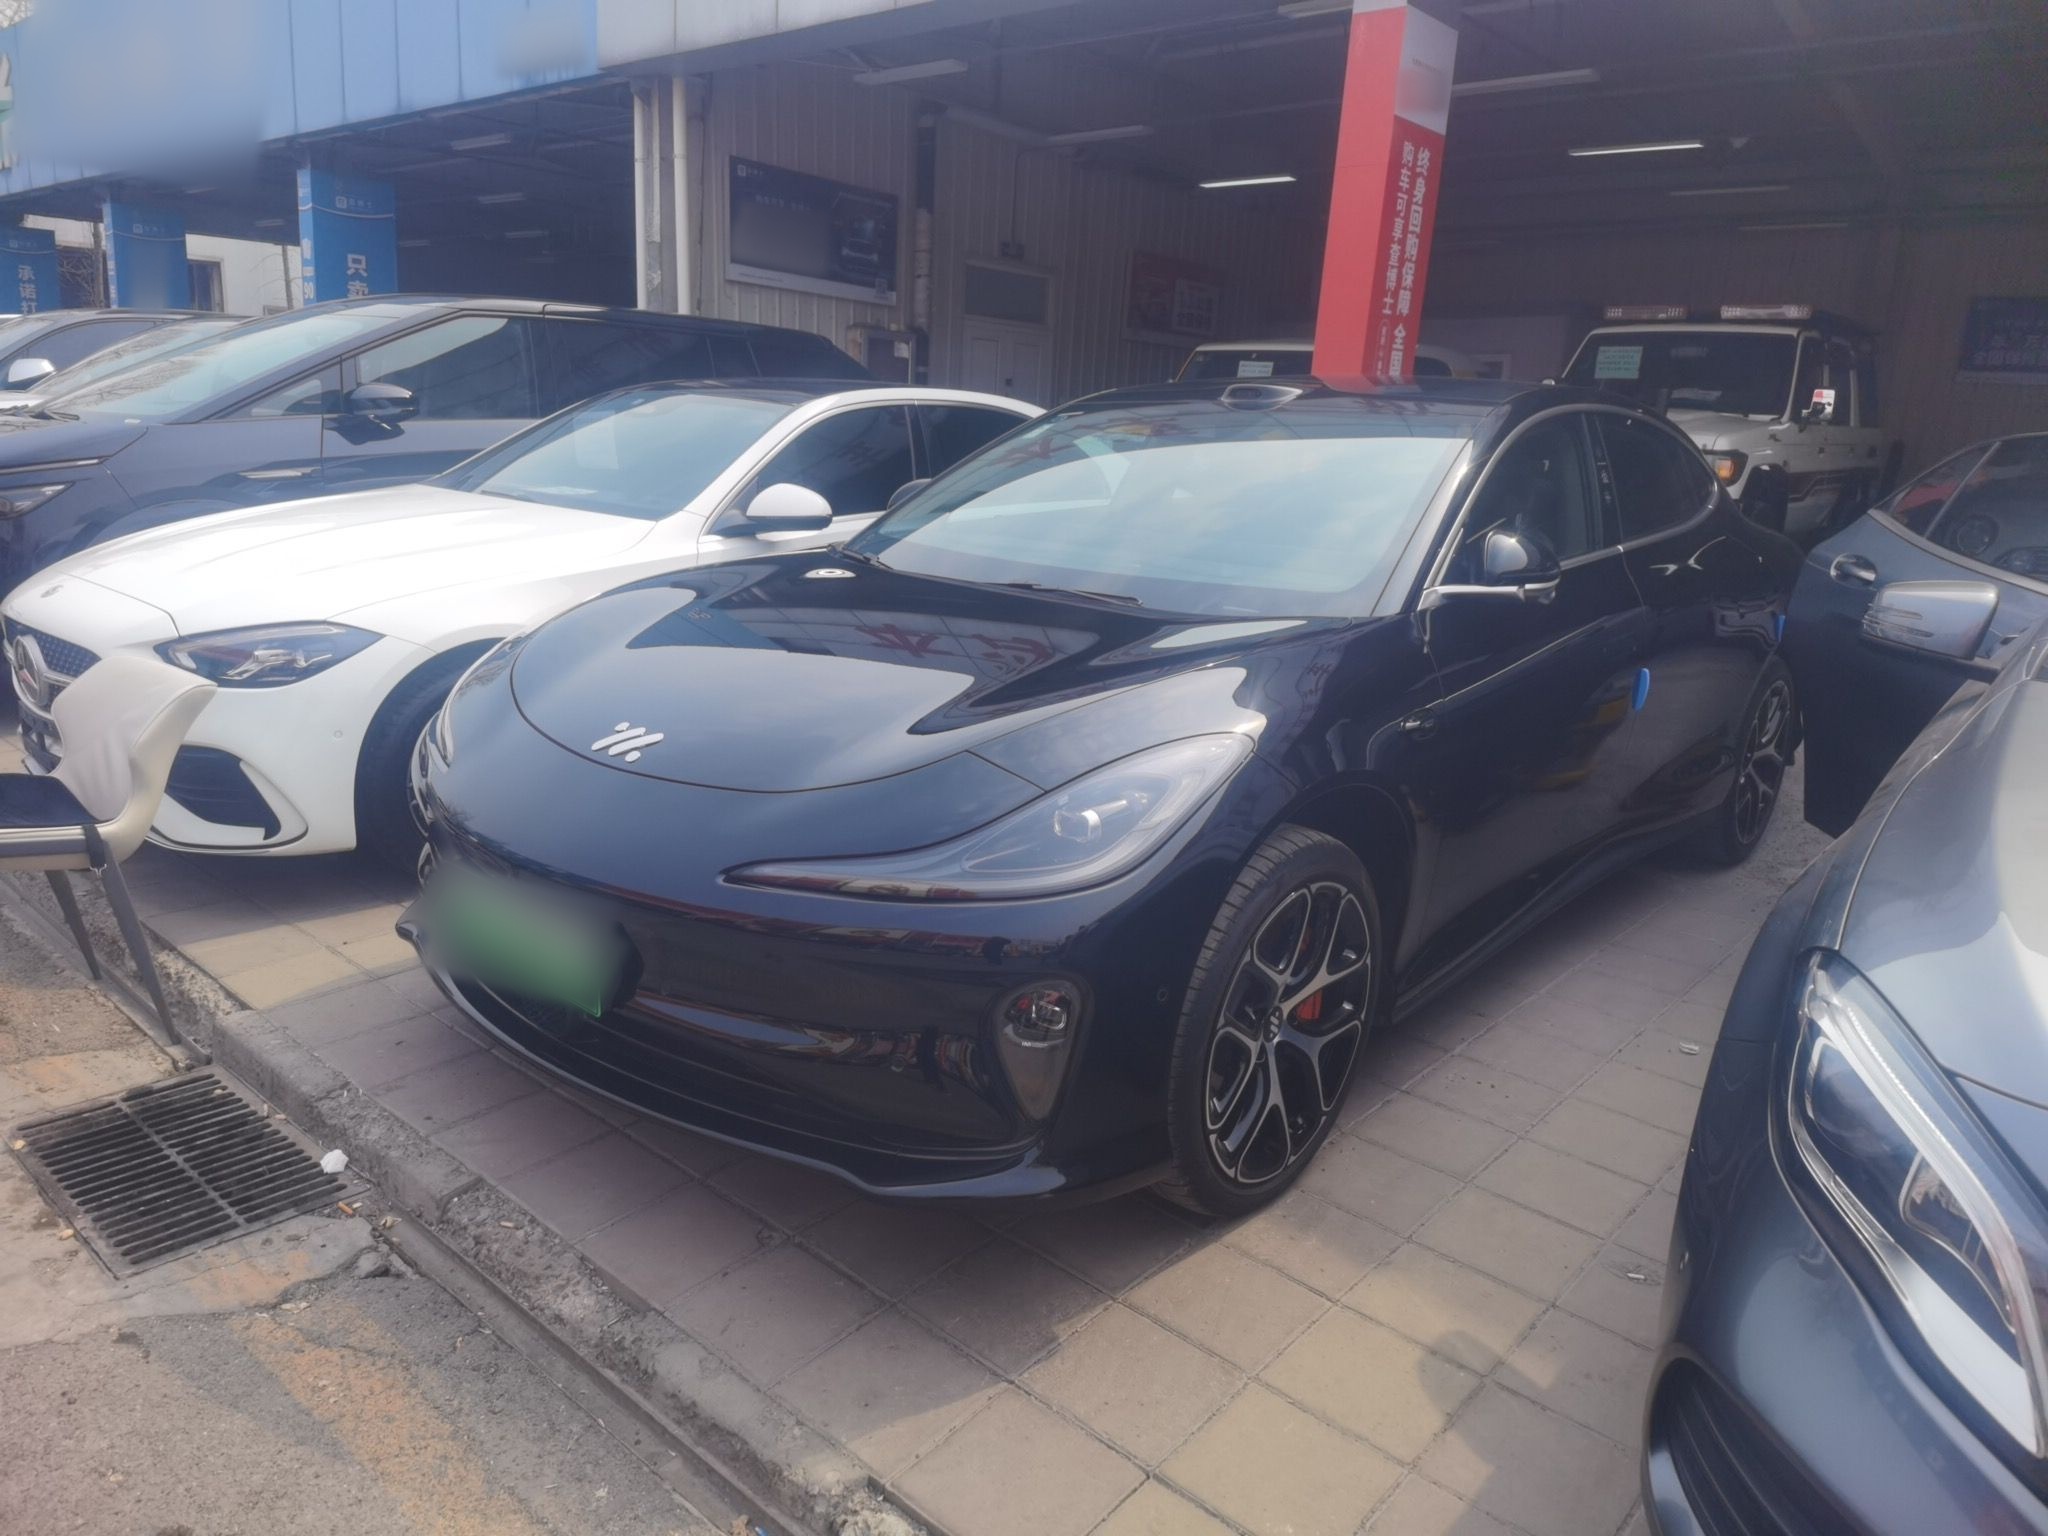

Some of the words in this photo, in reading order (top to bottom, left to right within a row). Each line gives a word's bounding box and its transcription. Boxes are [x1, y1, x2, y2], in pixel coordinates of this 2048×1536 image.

[1382, 141, 1415, 315] 购车可享查博士
[1397, 147, 1431, 317] 终身回购保障
